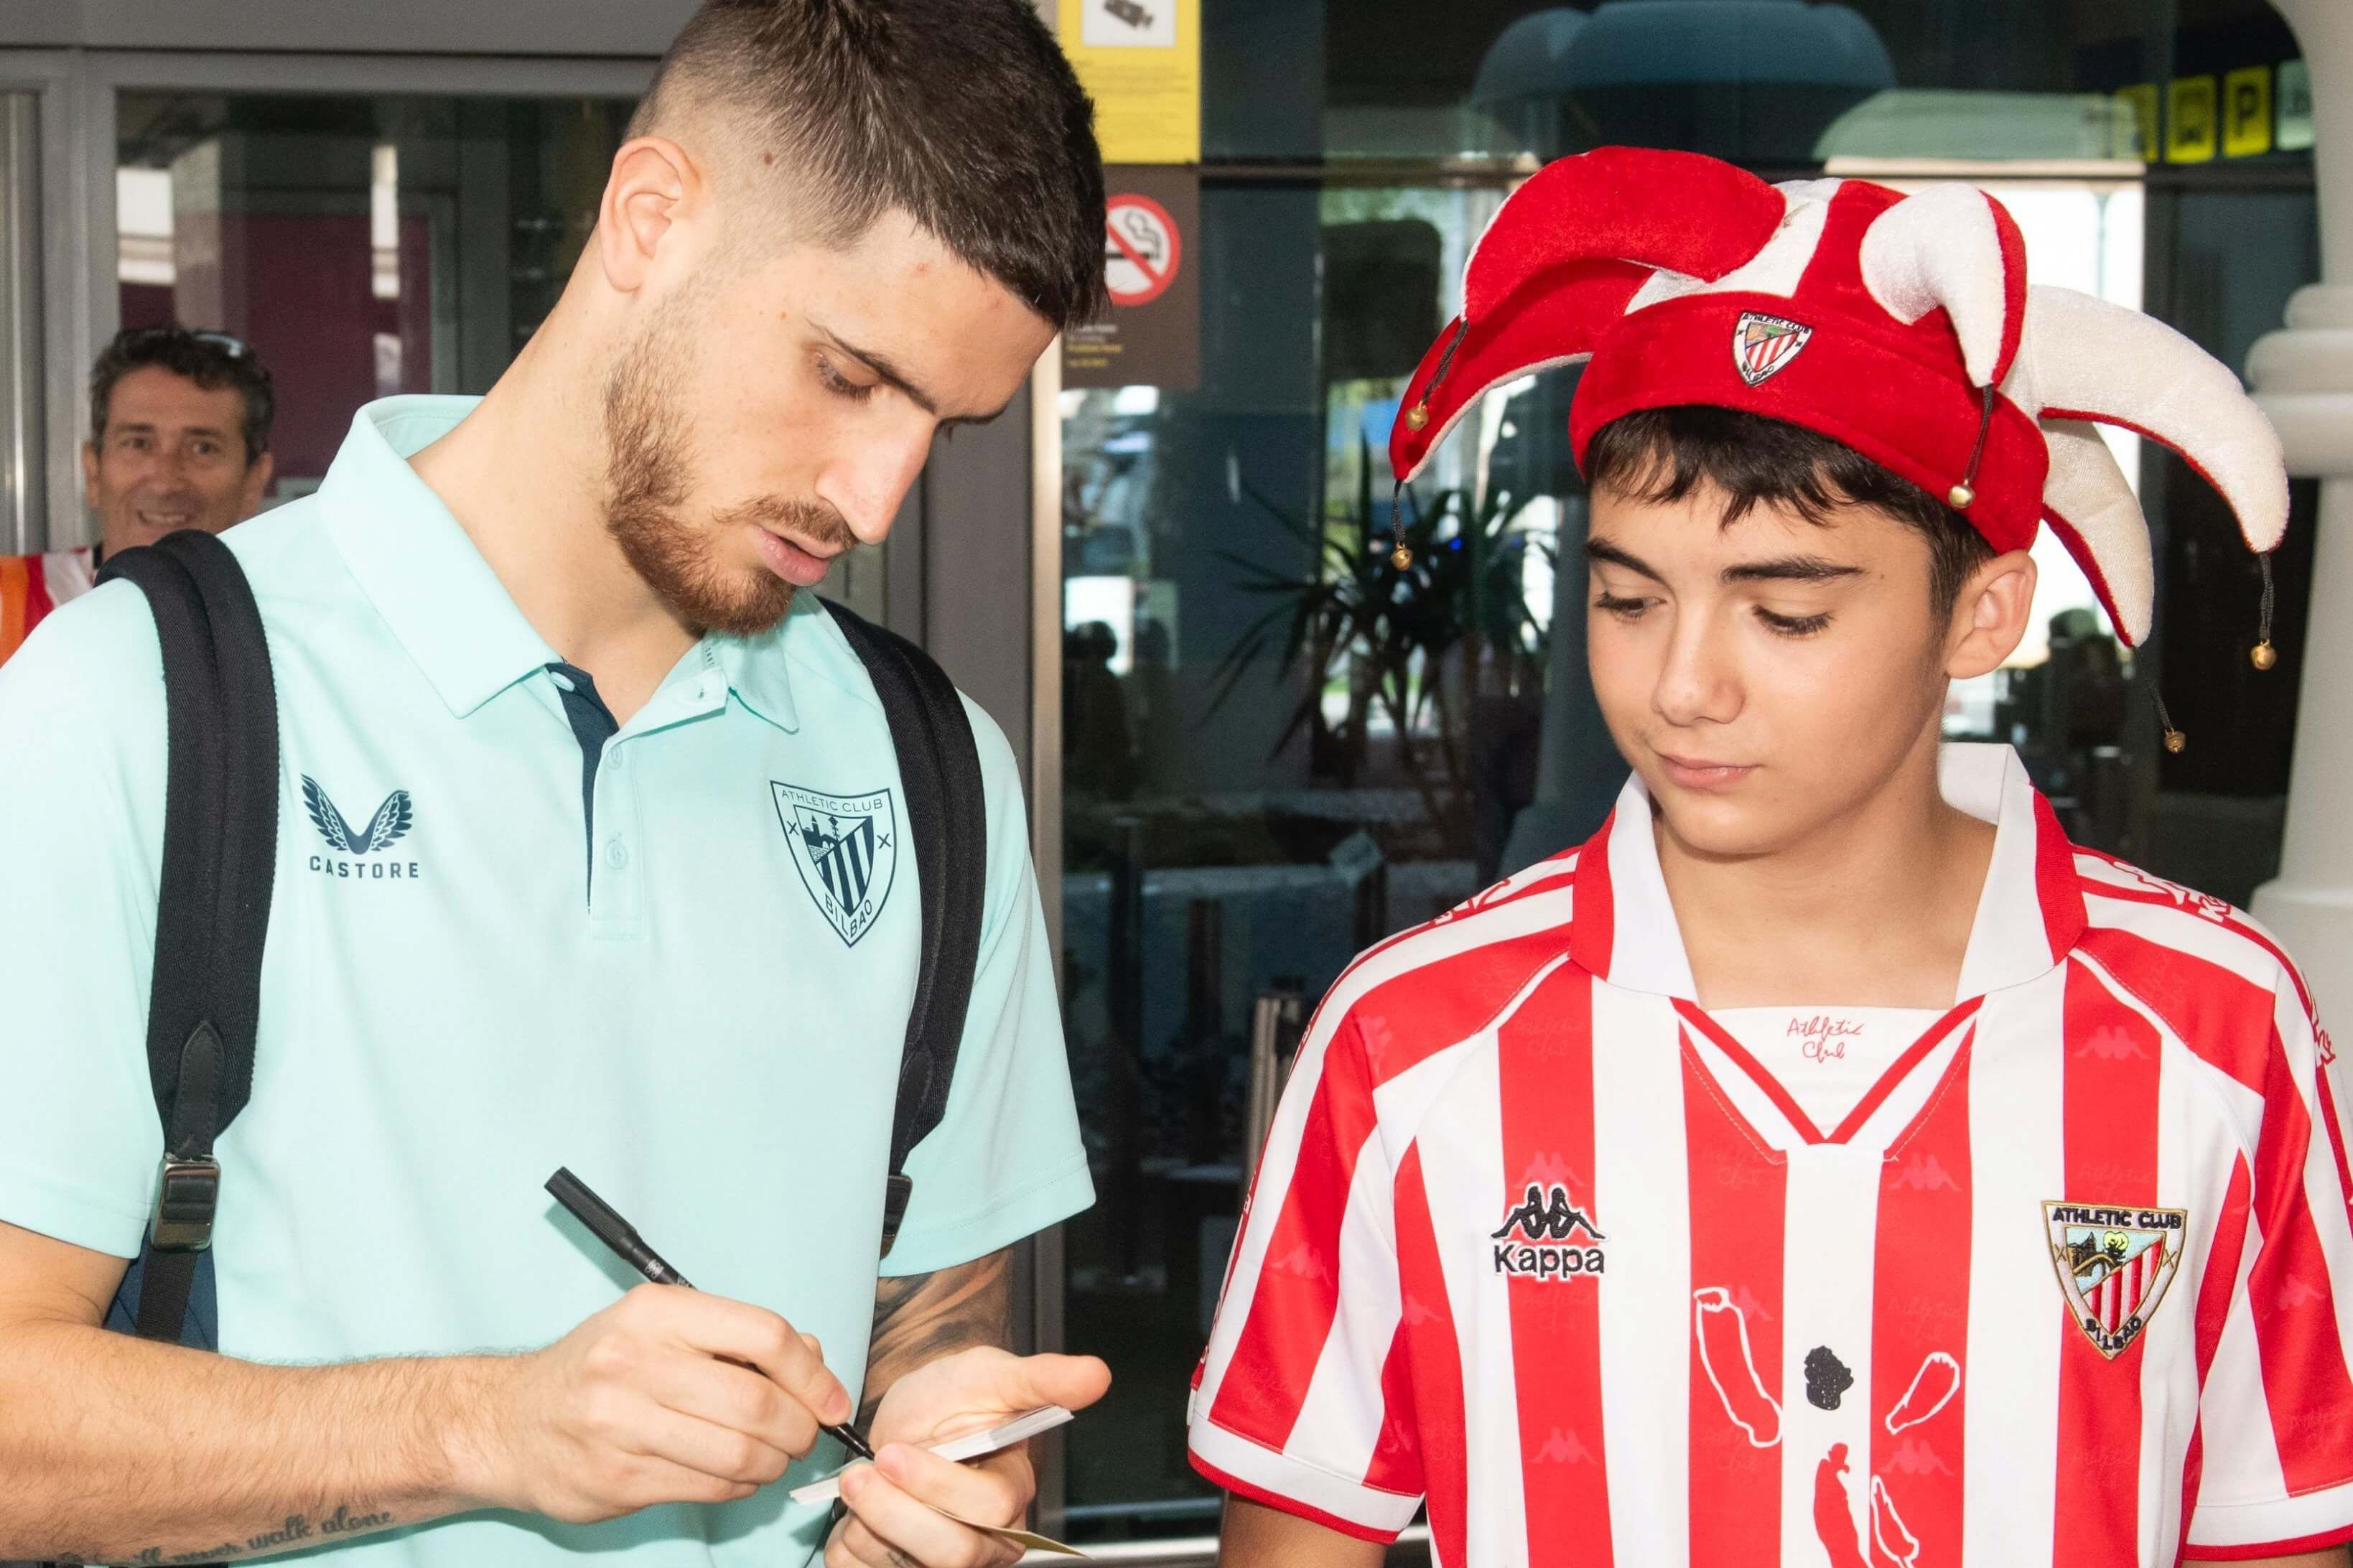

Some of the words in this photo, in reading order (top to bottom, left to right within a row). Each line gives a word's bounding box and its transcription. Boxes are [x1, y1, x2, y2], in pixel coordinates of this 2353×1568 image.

[781, 789, 839, 811] ATHLETIC
[842, 798, 883, 812] CLUB
[309, 855, 419, 879] CASTORE
[824, 892, 872, 938] BILBAO
[1786, 1015, 1865, 1042] Athletic
[1802, 1041, 1845, 1063] Club
[2053, 1207, 2133, 1227] ATHLETIC
[2138, 1211, 2182, 1229] CLUB
[1494, 1243, 1606, 1278] Kappa
[2084, 1316, 2143, 1350] BILBAO
[246, 1514, 314, 1549] walk
[322, 1505, 391, 1534] alone
